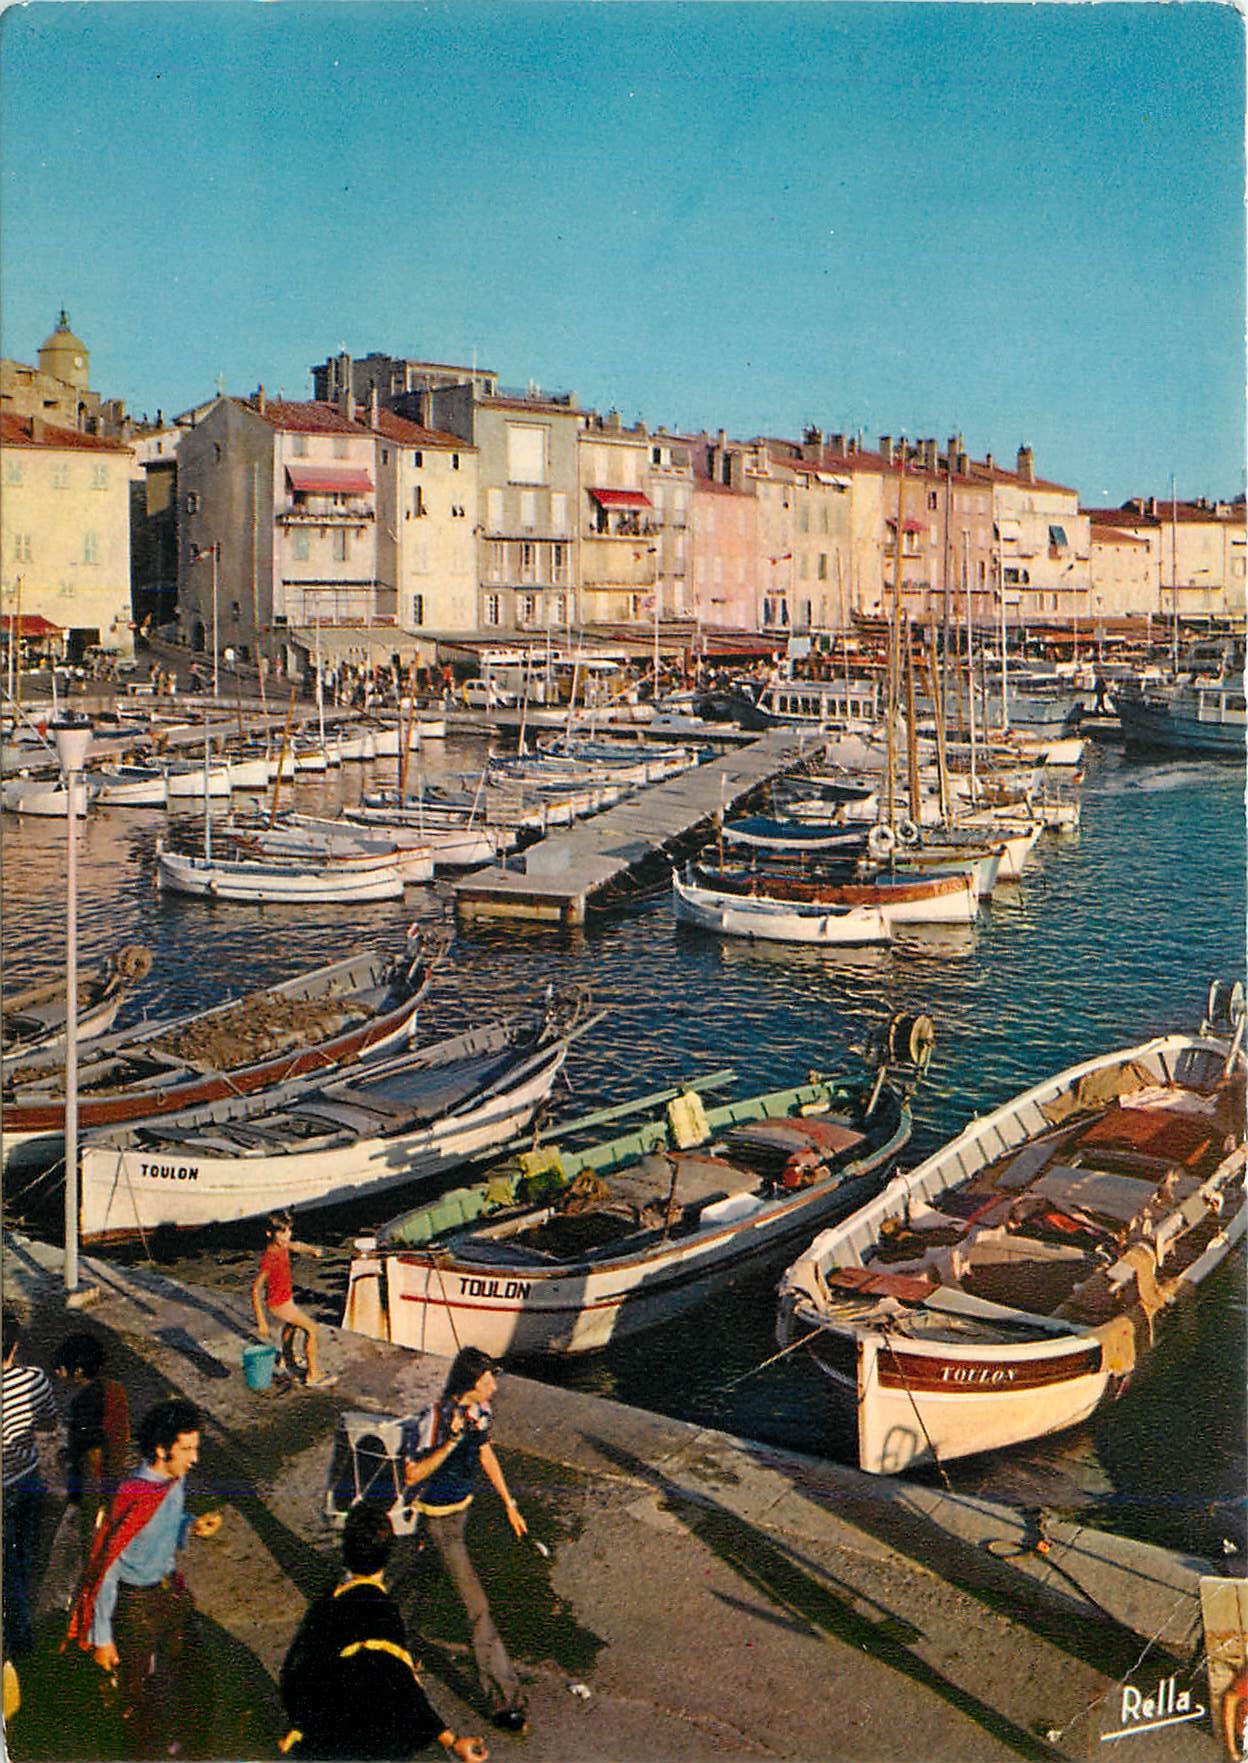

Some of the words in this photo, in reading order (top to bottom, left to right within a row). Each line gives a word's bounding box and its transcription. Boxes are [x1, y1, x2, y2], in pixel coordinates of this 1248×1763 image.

[141, 1164, 198, 1180] TOULON
[460, 1277, 531, 1299] TOULON
[941, 1366, 1017, 1384] TOULON
